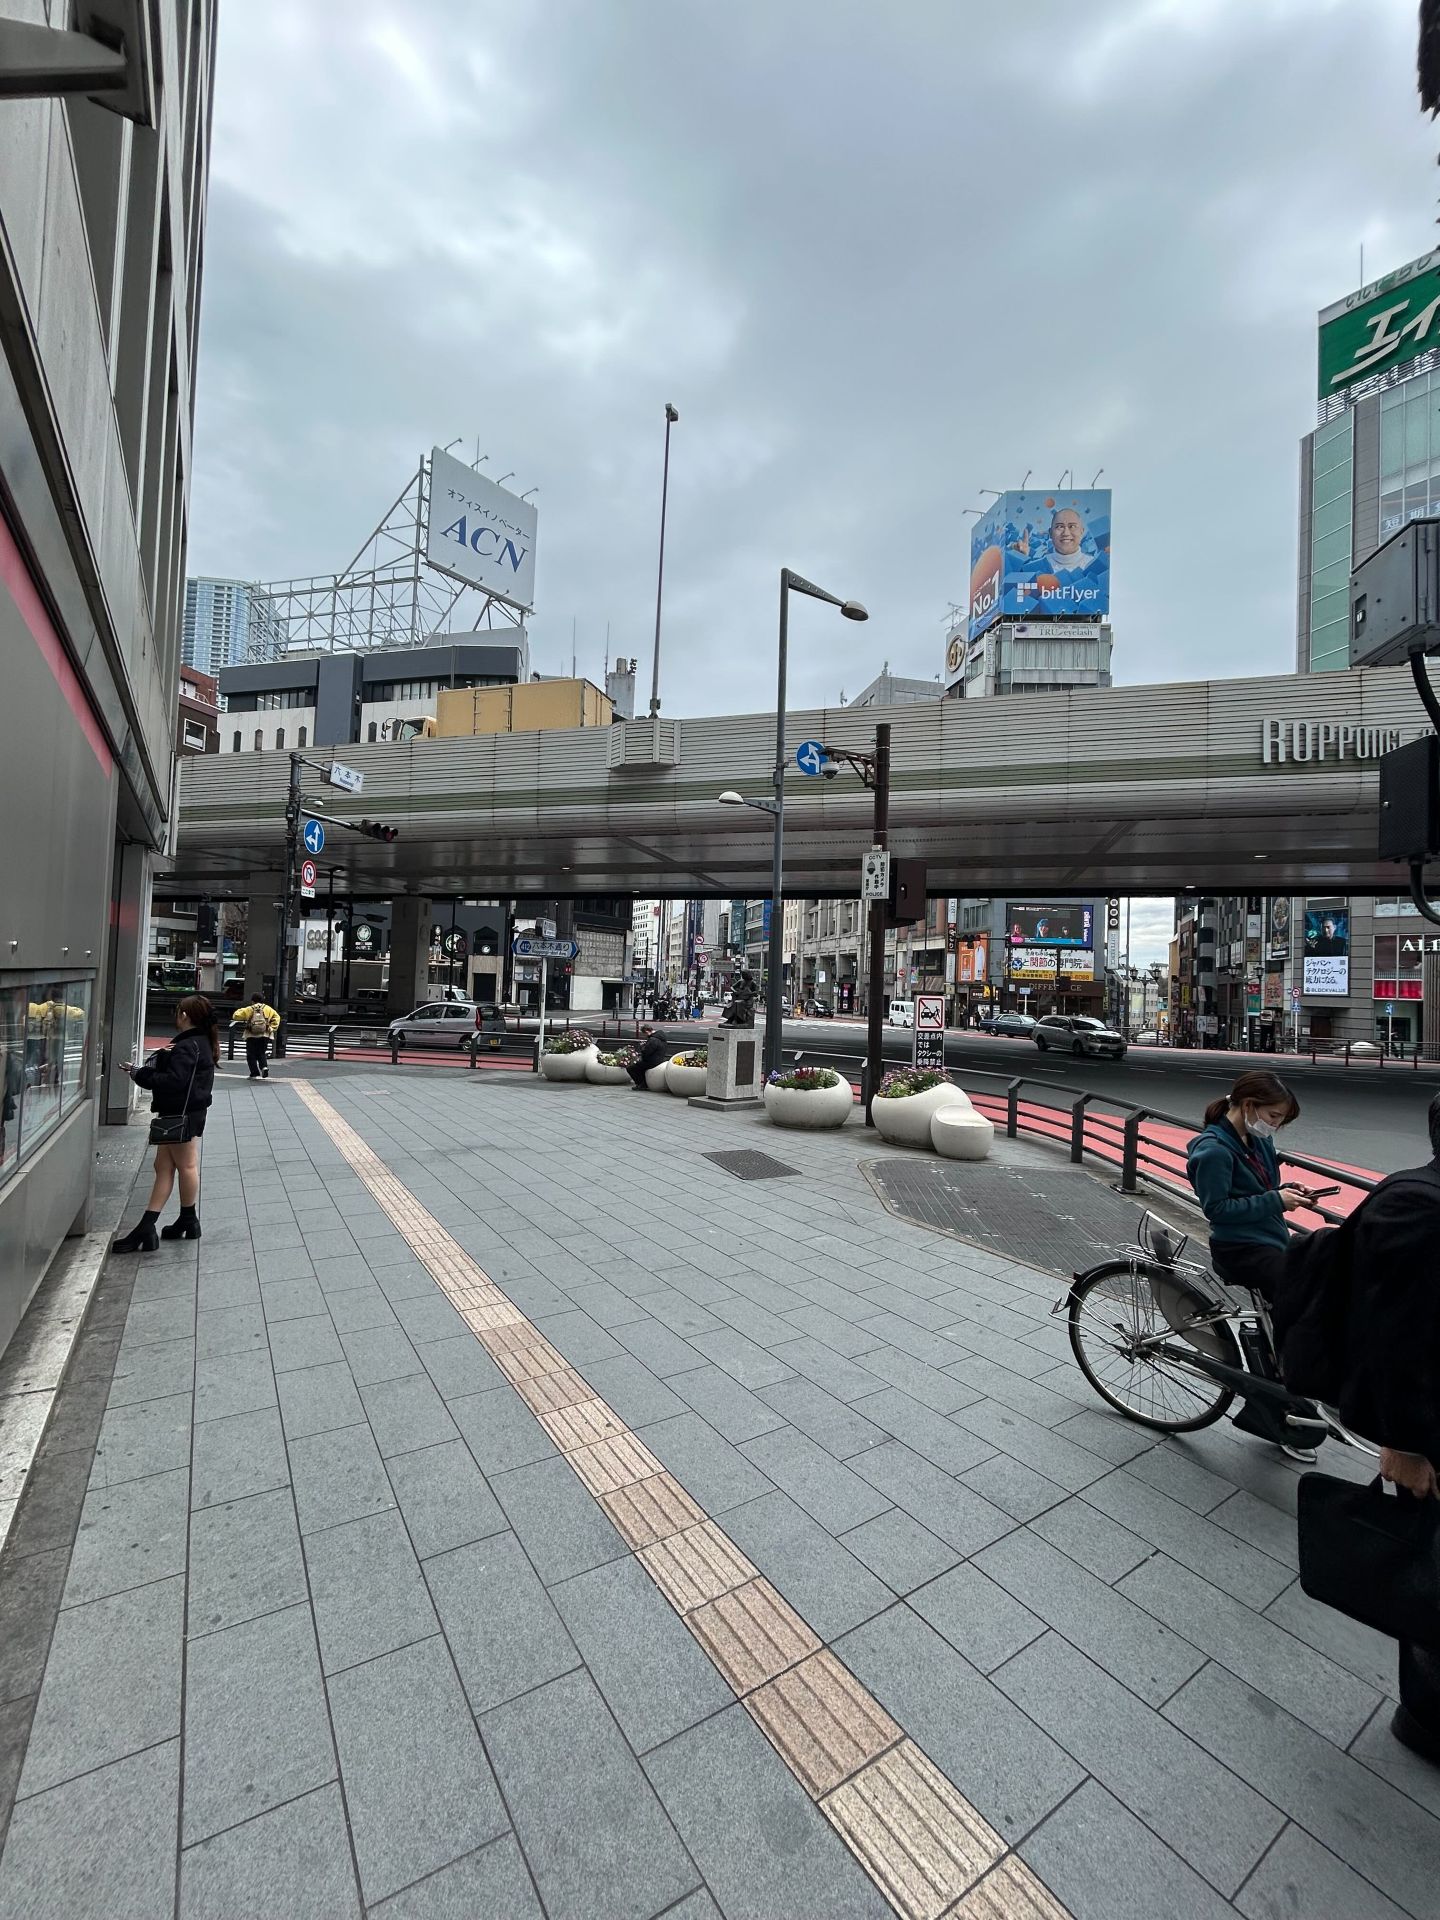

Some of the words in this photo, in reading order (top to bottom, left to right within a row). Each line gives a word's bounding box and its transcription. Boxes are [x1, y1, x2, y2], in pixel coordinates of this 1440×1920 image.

[1331, 290, 1440, 384] エイ
[447, 488, 530, 539] オフィスイノベーター
[440, 515, 529, 573] ACN
[972, 569, 1000, 620] No.1
[1041, 585, 1100, 602] bitFlyer
[1063, 627, 1093, 637] eyelash
[1306, 967, 1347, 975] テクノロジーの
[917, 1032, 943, 1041] 交差点内
[917, 1058, 942, 1066] 乗降禁止
